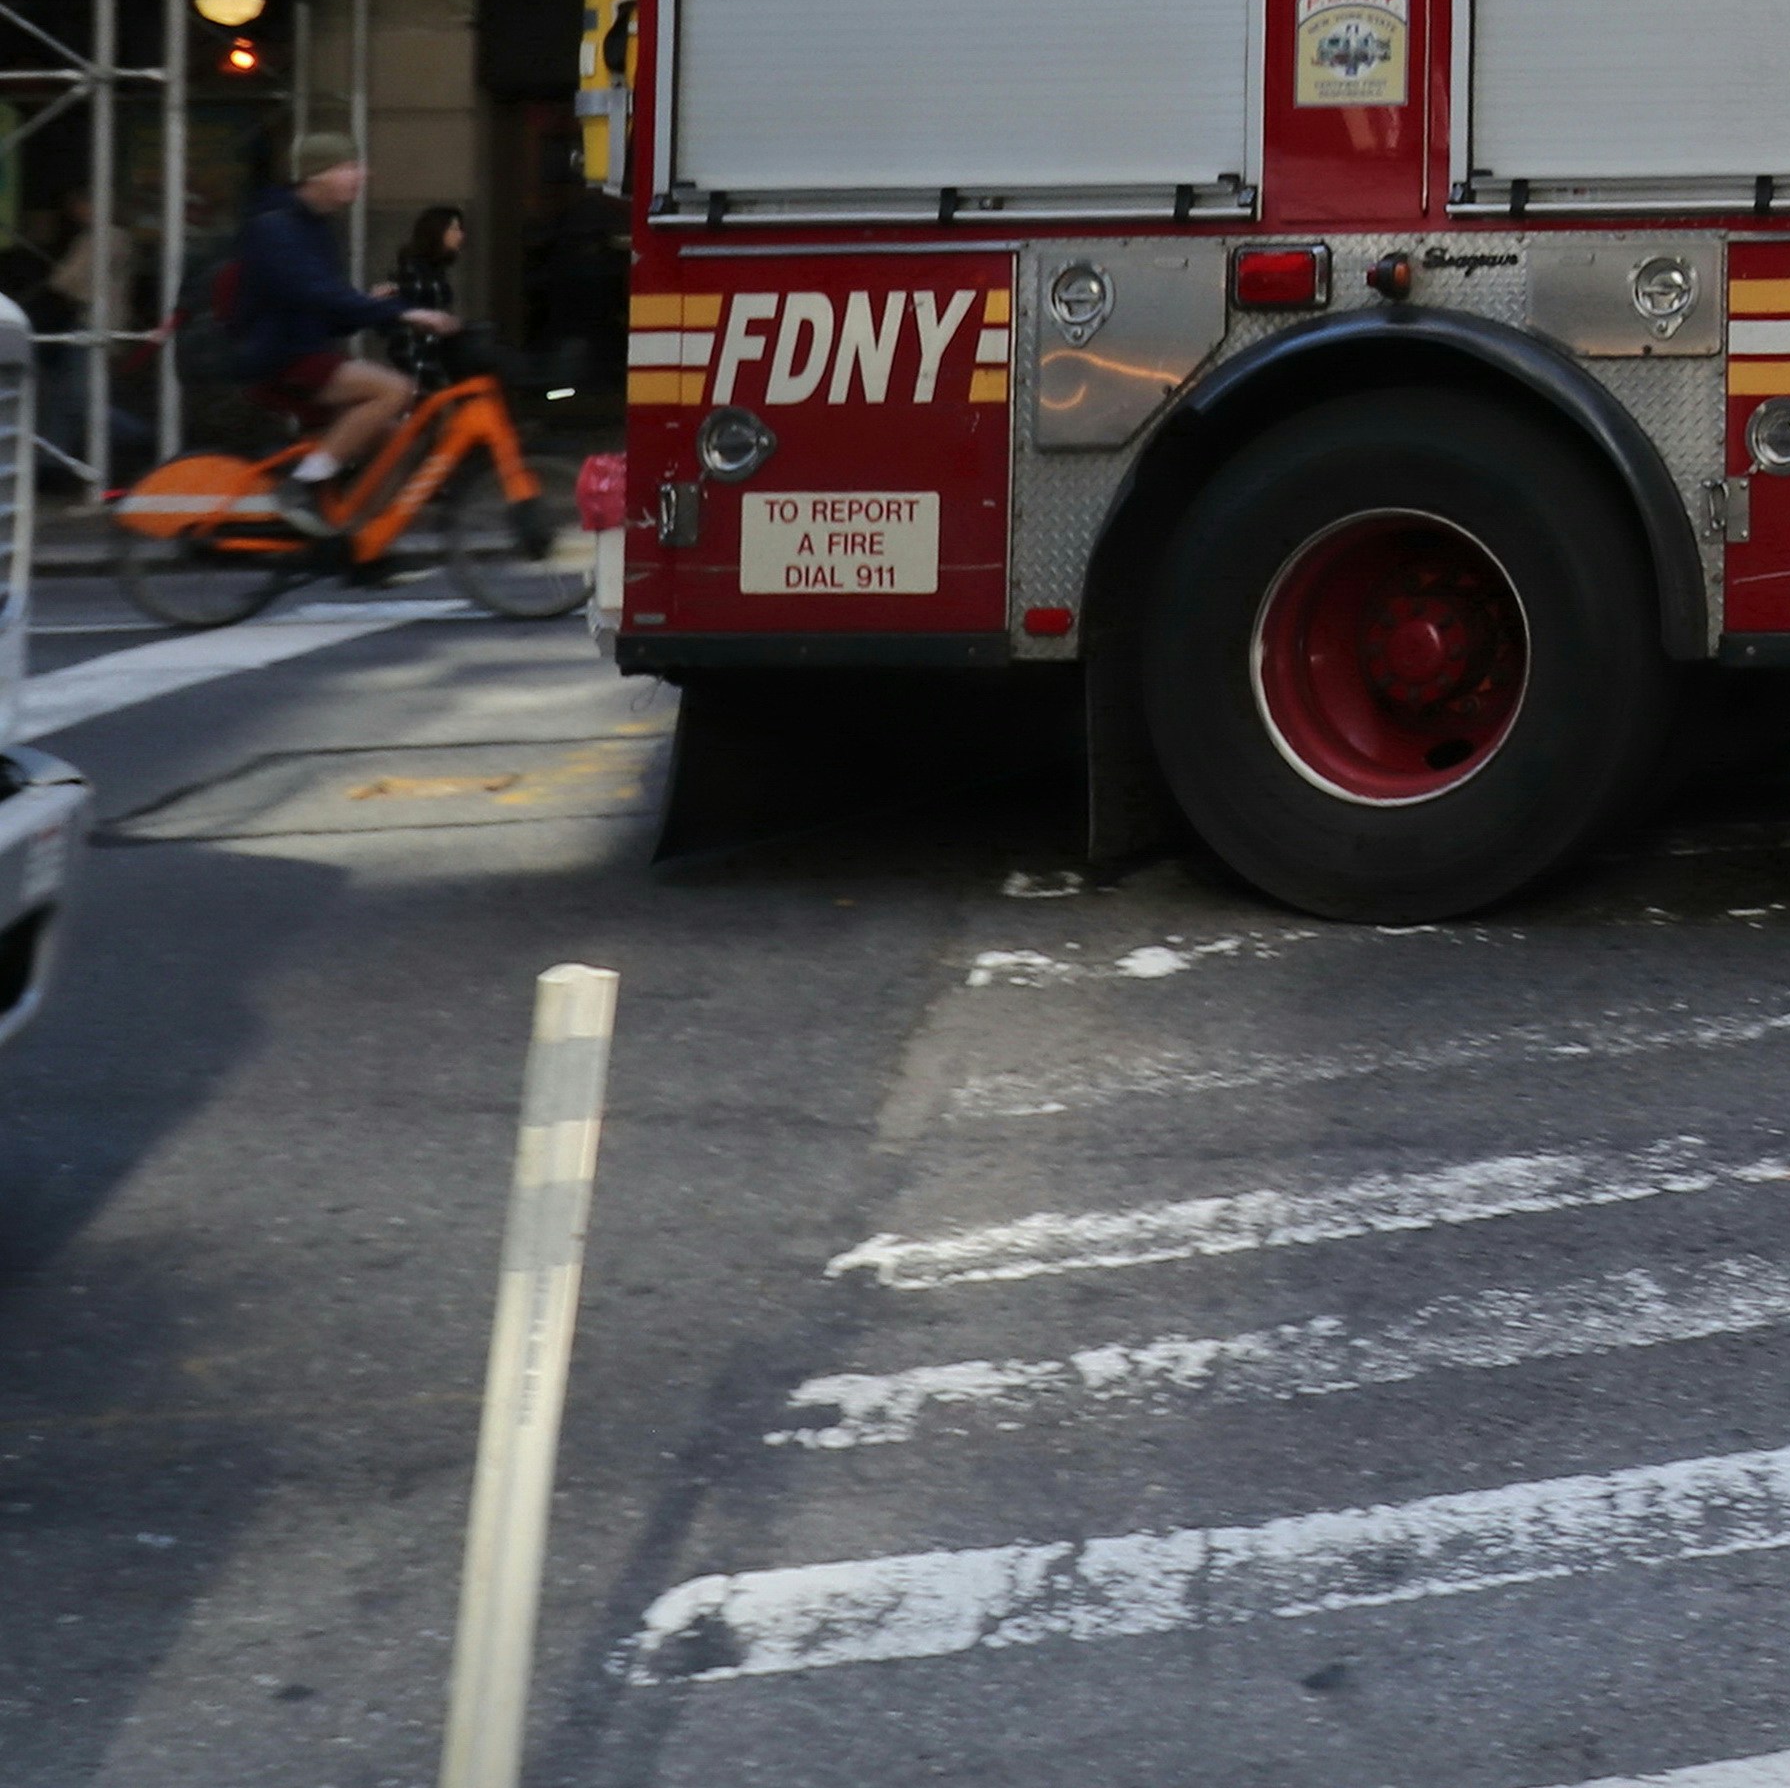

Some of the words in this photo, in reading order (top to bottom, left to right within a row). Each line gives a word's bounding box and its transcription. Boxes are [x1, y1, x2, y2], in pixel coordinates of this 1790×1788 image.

[711, 289, 977, 406] FDNY
[764, 500, 799, 524] TO
[811, 499, 920, 524] REPORT
[798, 533, 814, 556] A
[828, 533, 884, 556] FIRE
[785, 565, 844, 589] DIAL
[856, 565, 896, 589] 911
